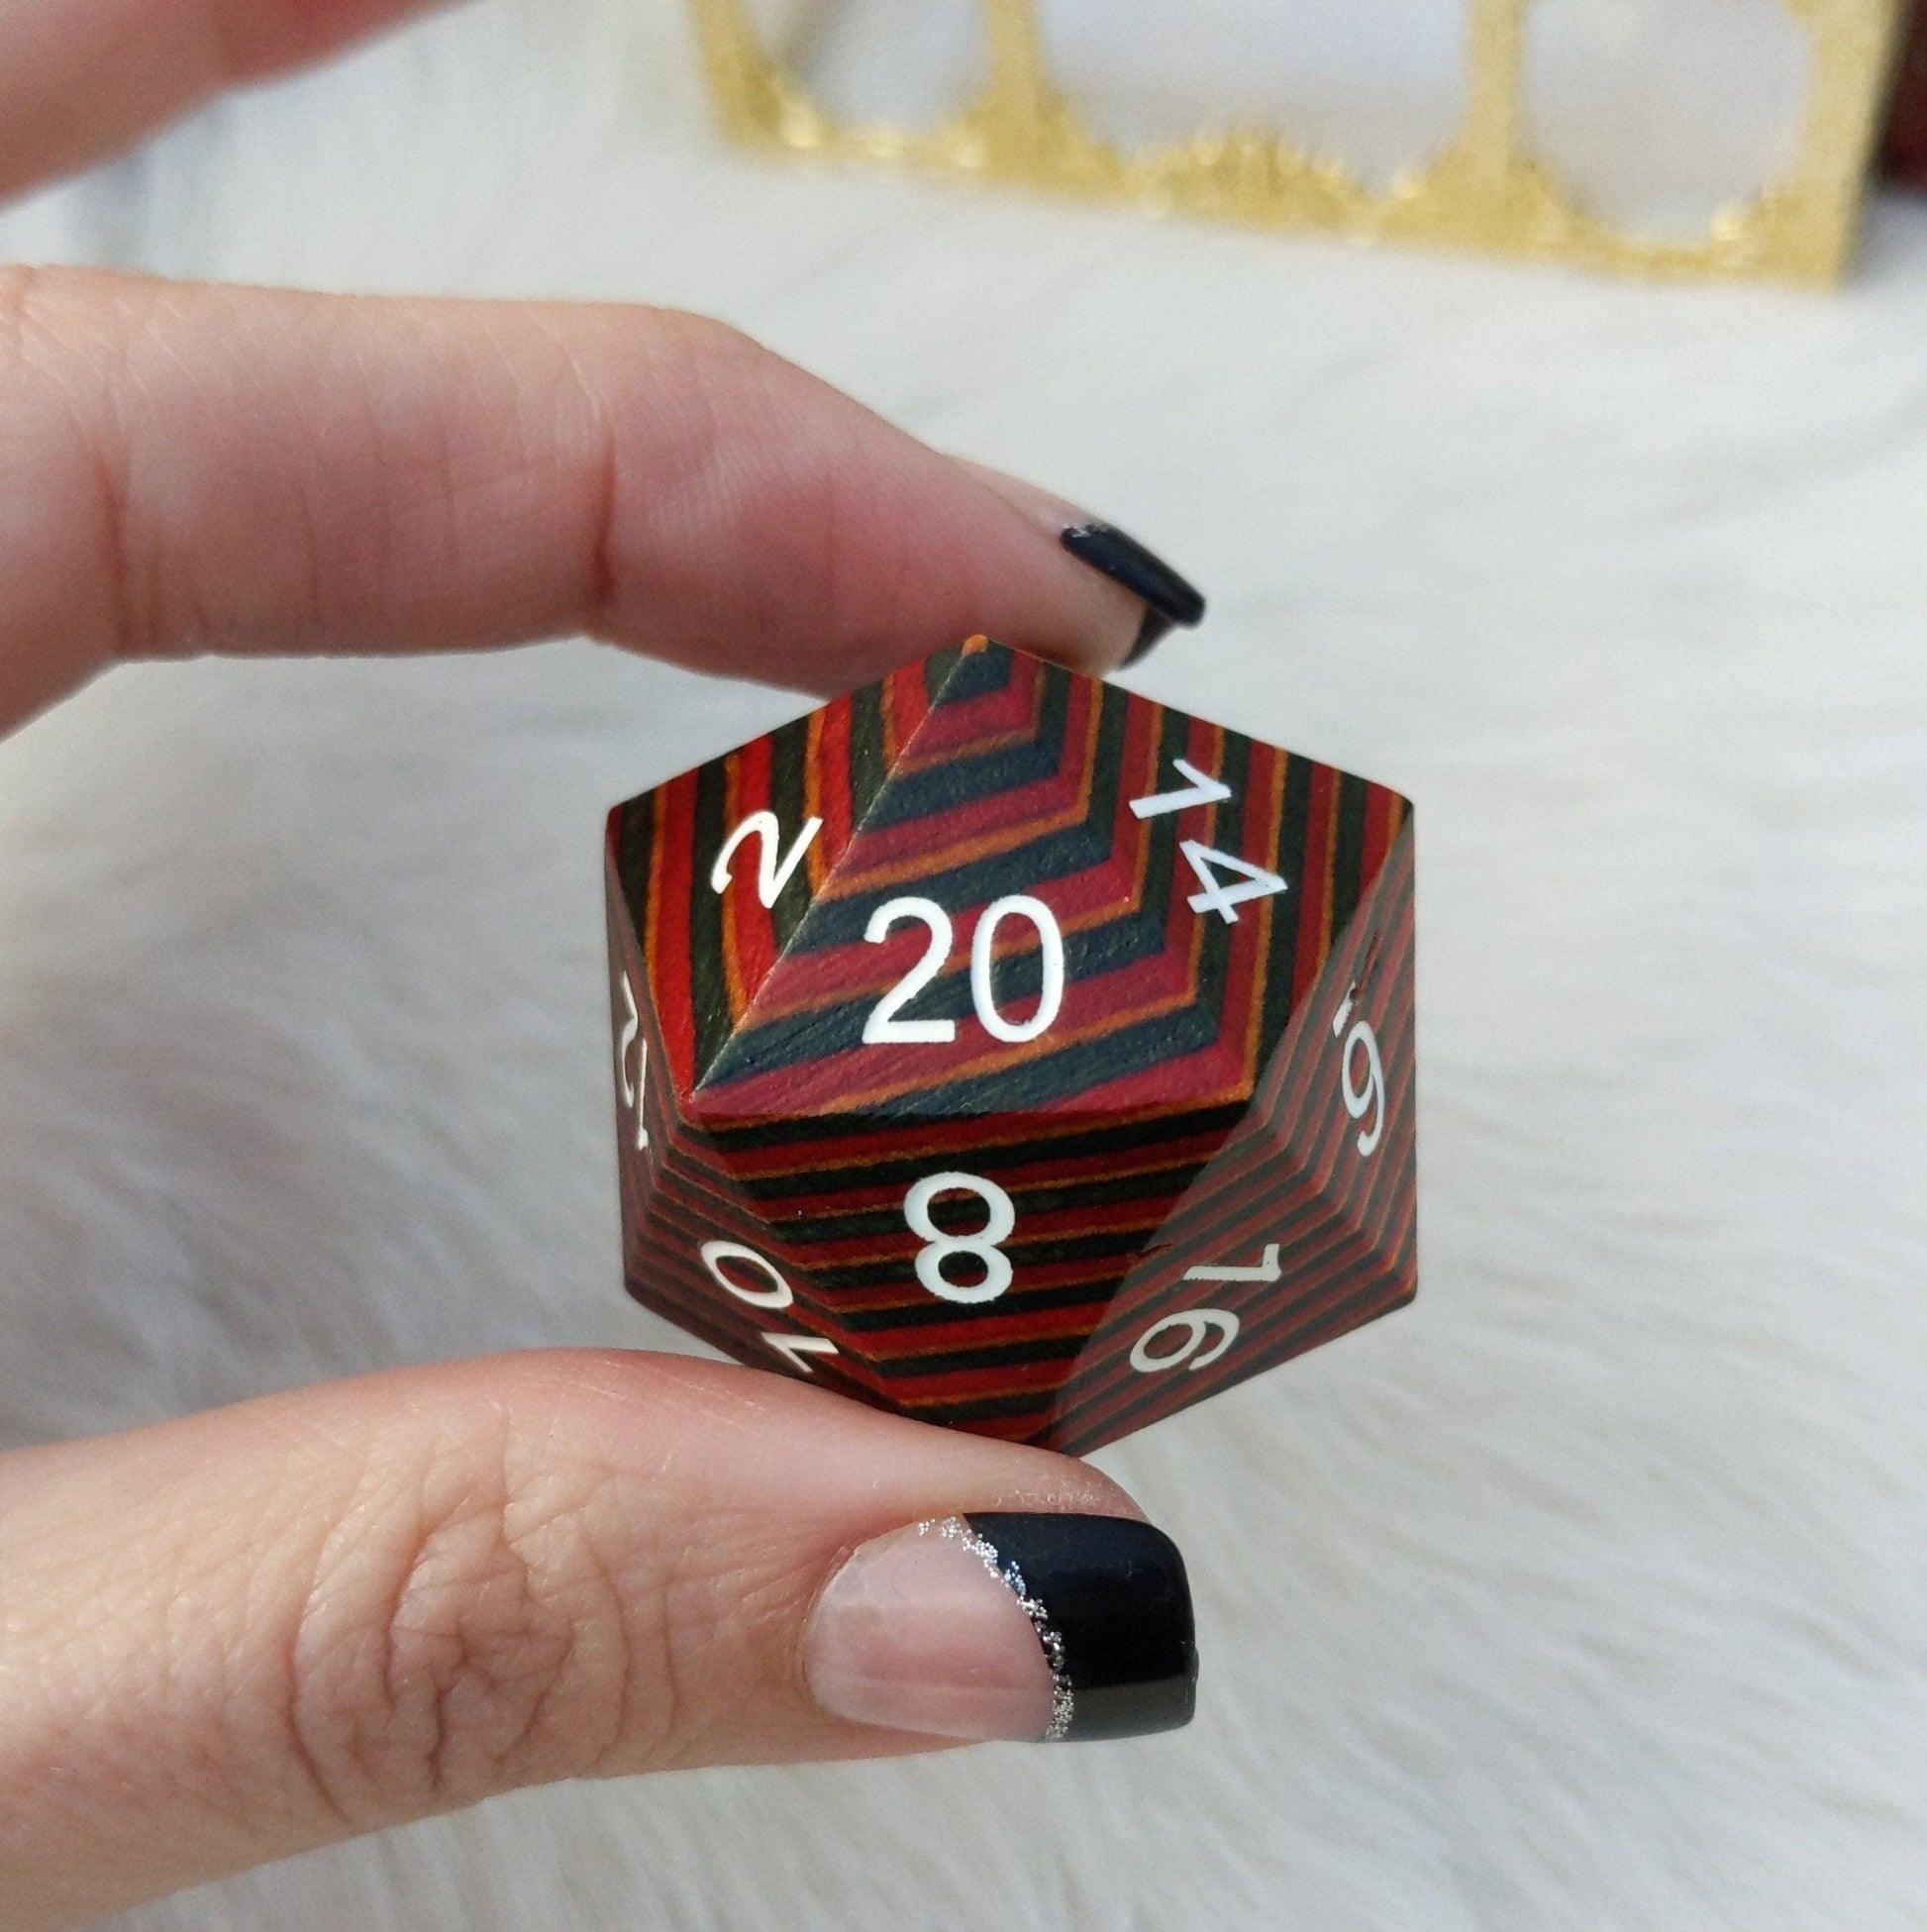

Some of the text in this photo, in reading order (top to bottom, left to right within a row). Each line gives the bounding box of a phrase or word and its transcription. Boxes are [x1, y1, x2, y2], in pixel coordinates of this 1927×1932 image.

[710, 810, 824, 909] 2
[1129, 759, 1288, 924] 14
[862, 894, 1066, 1046] 20
[904, 1171, 1015, 1304] 8
[701, 1241, 840, 1373] 10
[1130, 1243, 1282, 1373] 16
